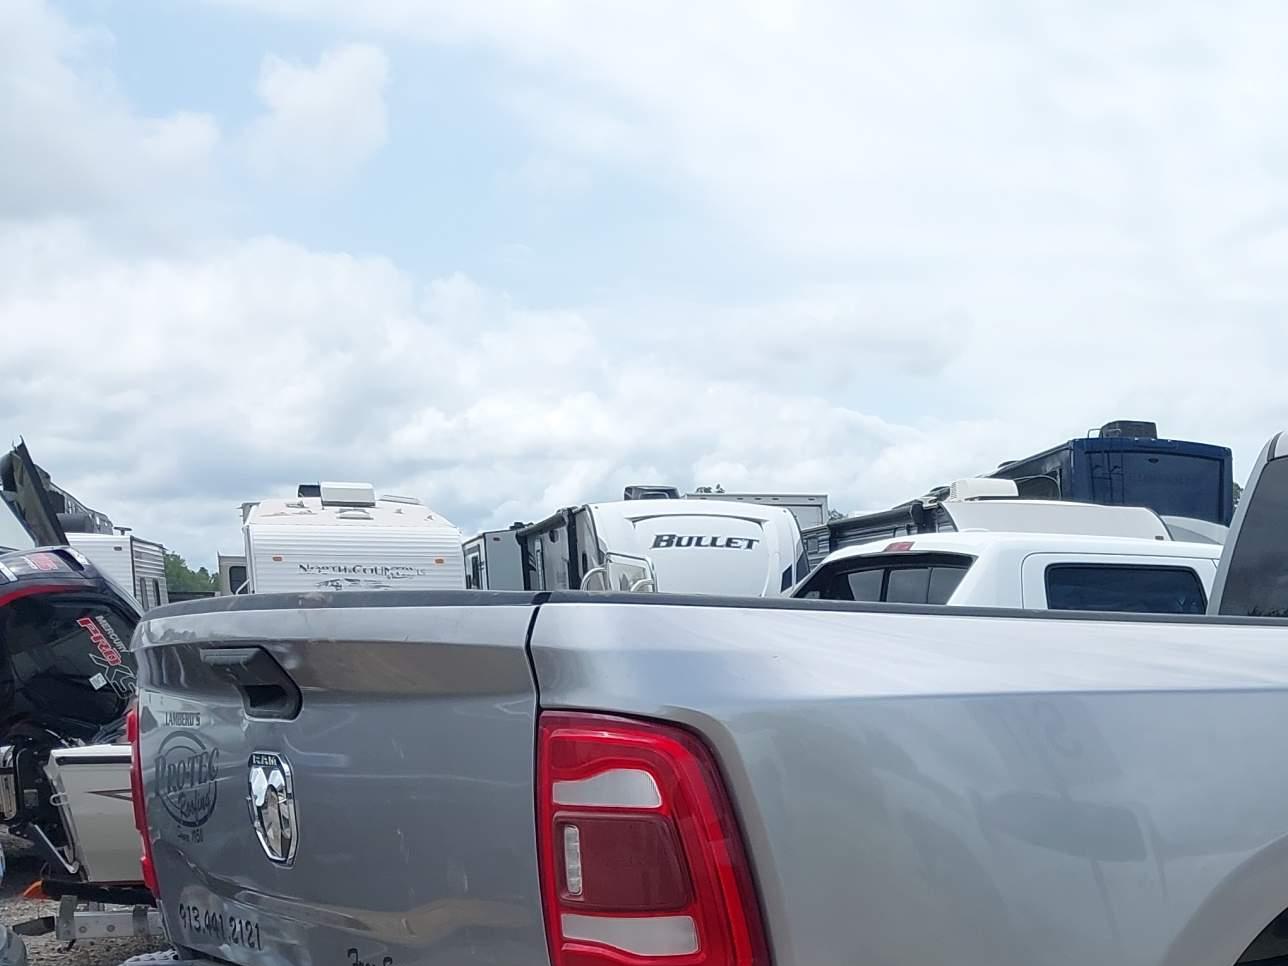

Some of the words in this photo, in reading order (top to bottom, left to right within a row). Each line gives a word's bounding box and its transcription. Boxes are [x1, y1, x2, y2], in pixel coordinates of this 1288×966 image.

[651, 533, 761, 551] BULLET
[76, 616, 123, 667] PRO
[95, 615, 131, 653] MERCURY
[164, 712, 201, 727] LAMBERD'S
[153, 747, 220, 797] PRO-TEC
[252, 755, 278, 766] RAM
[178, 903, 262, 951] 913.441.2121
